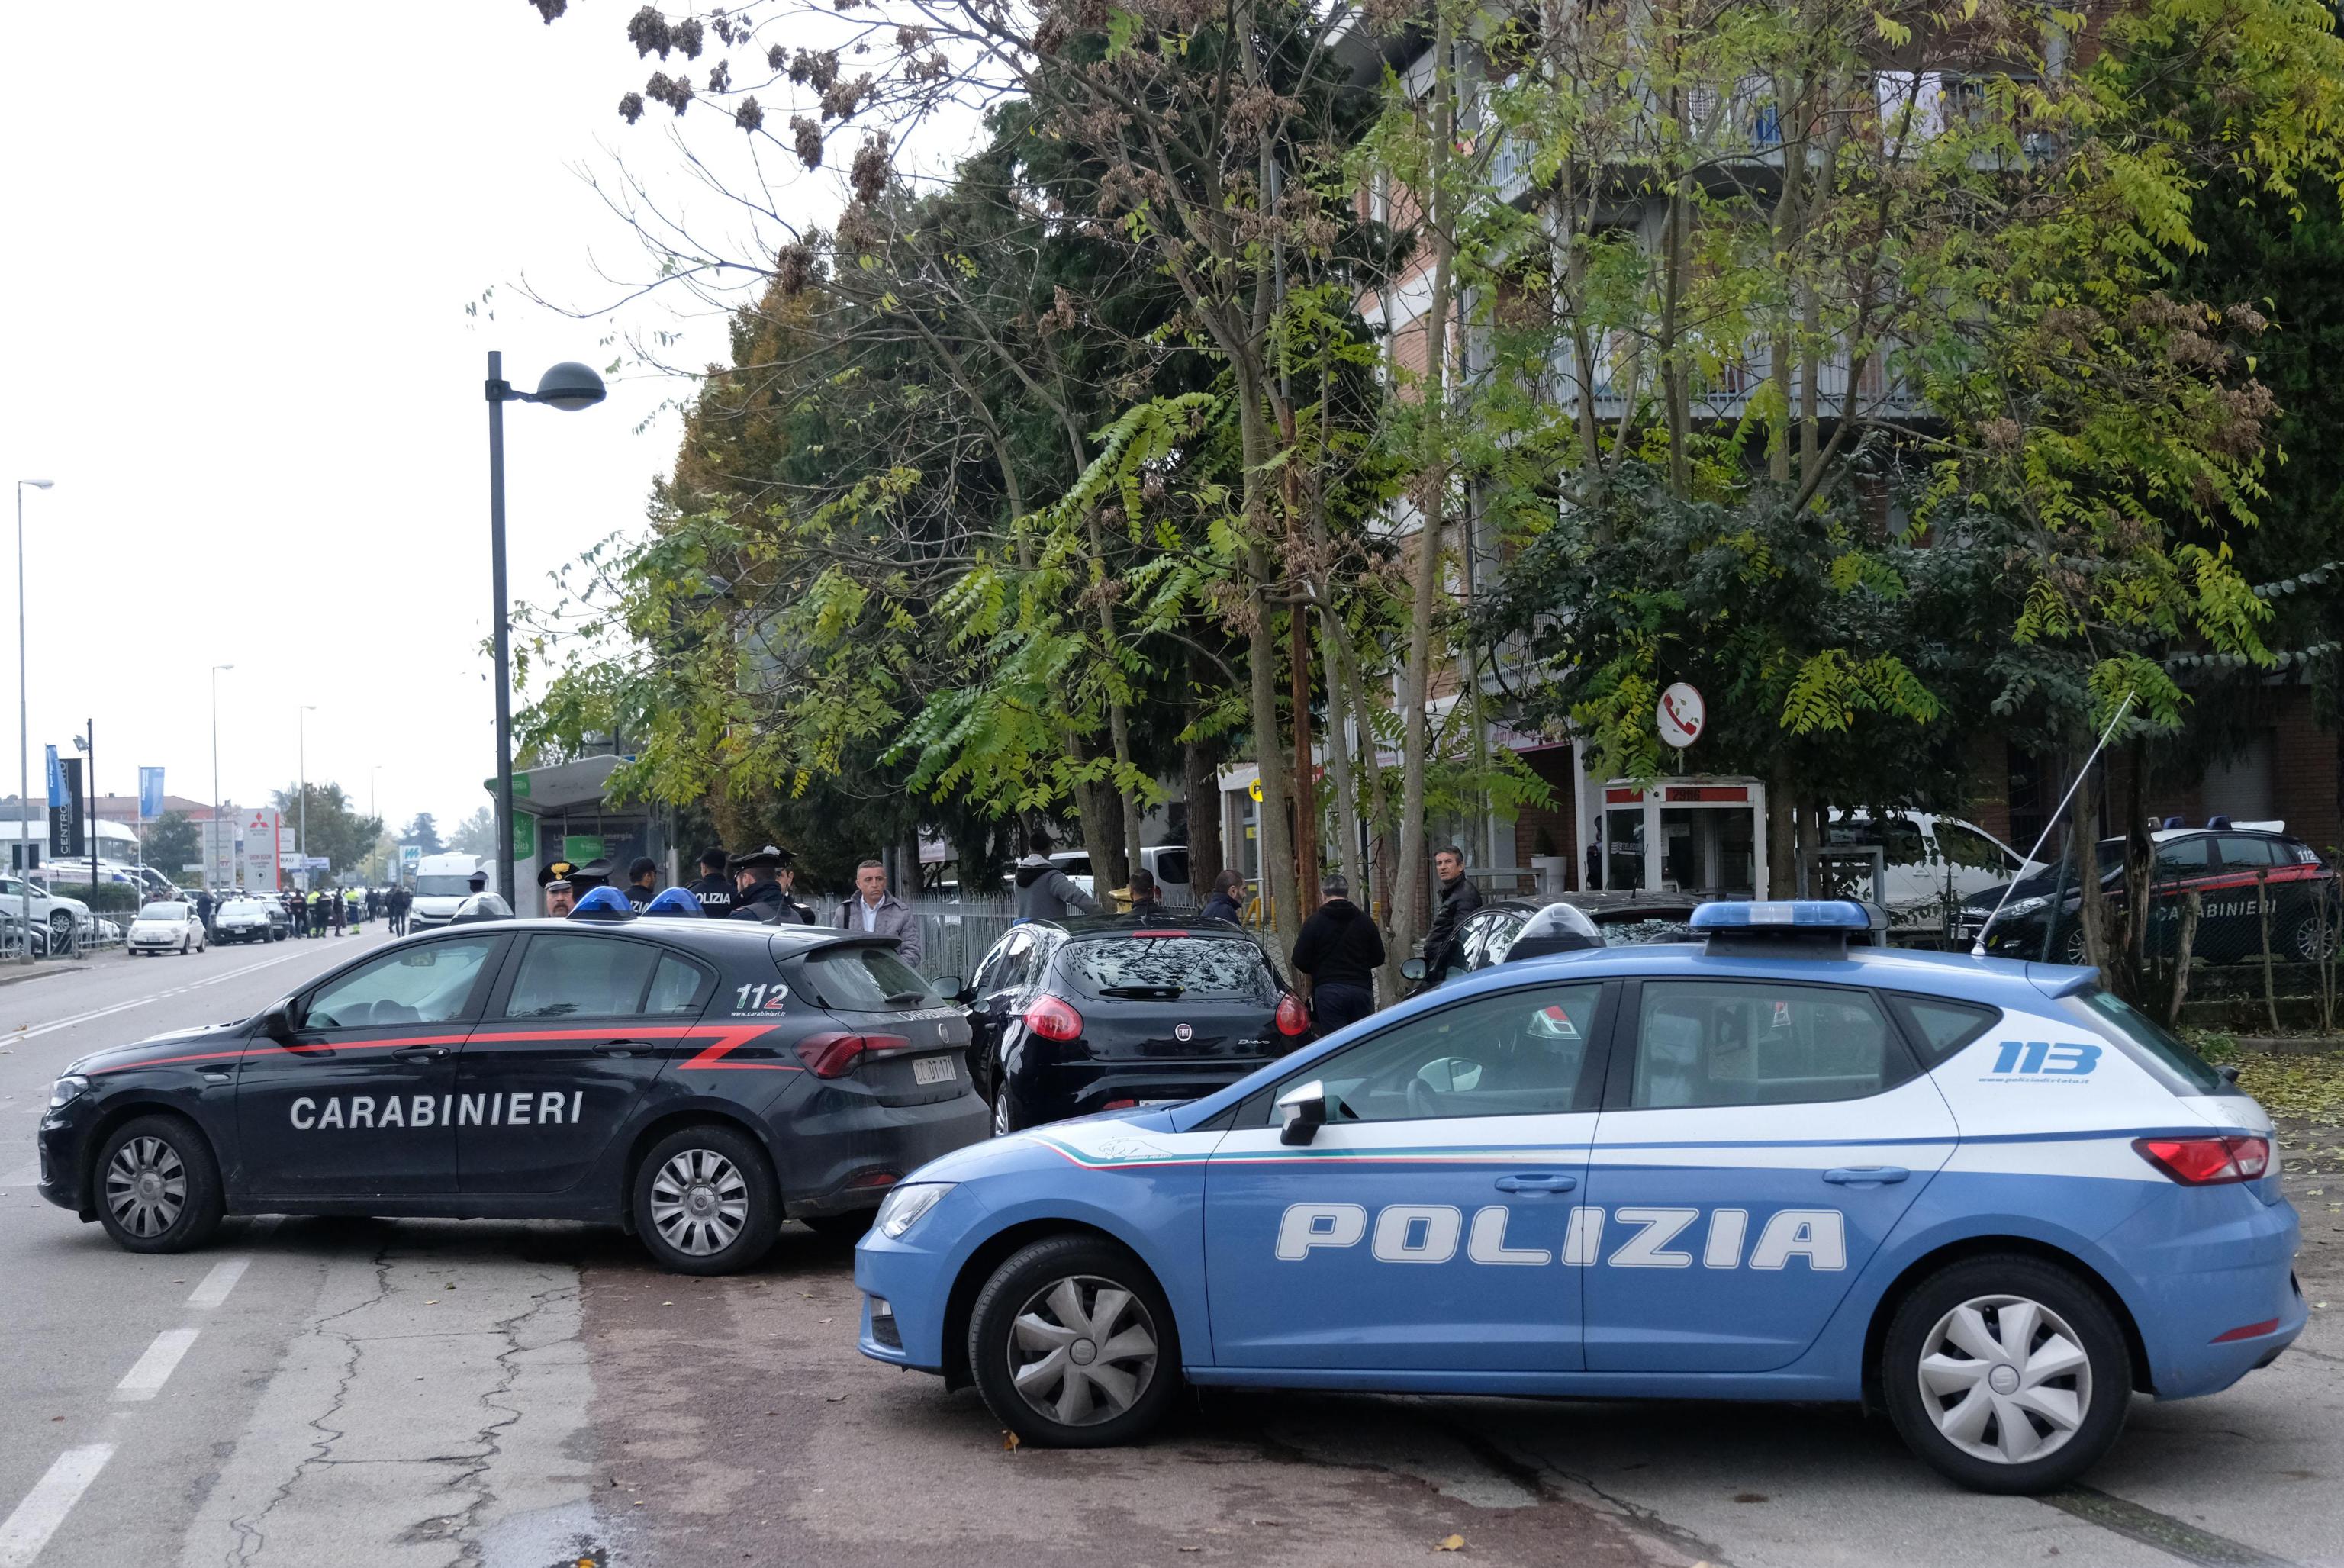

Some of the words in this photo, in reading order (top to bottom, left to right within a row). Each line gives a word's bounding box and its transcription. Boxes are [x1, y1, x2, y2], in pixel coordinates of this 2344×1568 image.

[60, 805, 69, 855] CENTRO
[2297, 849, 2317, 861] 112
[695, 892, 731, 905] OLIZIA
[2156, 899, 2277, 922] CAABINIERI
[736, 984, 789, 1009] 112
[1179, 1029, 1189, 1037] FIAT
[1992, 1041, 2103, 1075] 113
[290, 1091, 584, 1130] CARABINIERI
[1275, 1203, 1848, 1271] POLIZIA
